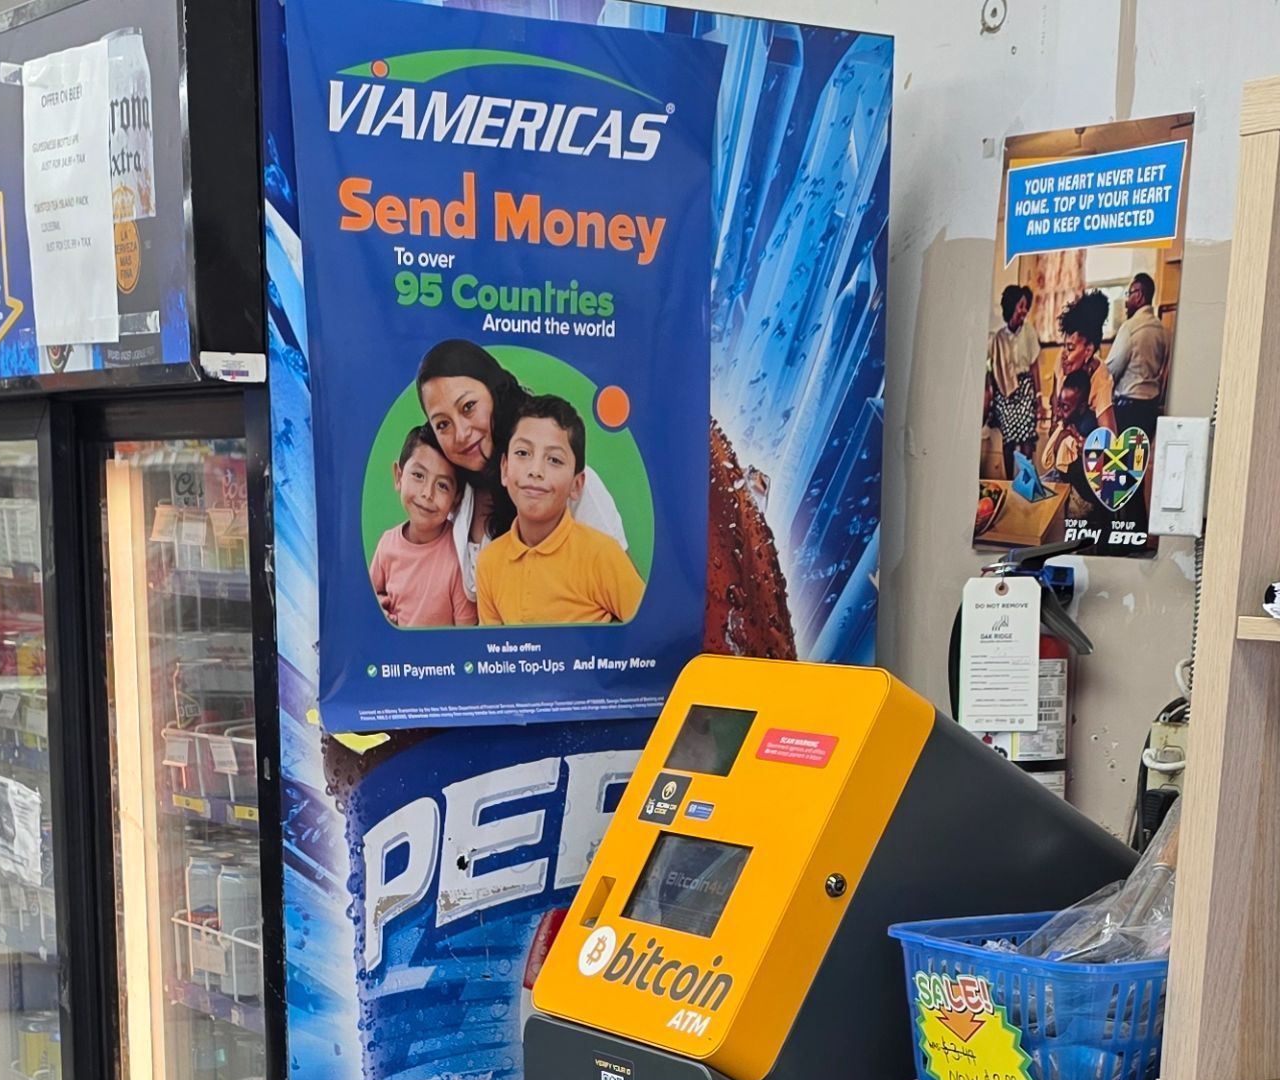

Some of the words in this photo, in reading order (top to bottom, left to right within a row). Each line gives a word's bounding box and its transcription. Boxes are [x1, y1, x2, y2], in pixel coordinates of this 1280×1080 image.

[328, 79, 669, 162] VIAMERICAS
[1025, 177, 1054, 195] YOUR
[1057, 172, 1095, 191] HEART
[1096, 168, 1133, 188] NEVER
[1136, 164, 1167, 183] LEFT
[1015, 198, 1049, 217] HOME.
[1053, 195, 1076, 213] TOP
[1079, 194, 1095, 210] UP
[1097, 190, 1129, 209] YOUR
[1132, 185, 1172, 205] HEART
[338, 171, 477, 240] Send
[494, 191, 667, 265] Money
[1025, 218, 1051, 236] AND
[1053, 215, 1080, 234] KEEP
[1083, 208, 1155, 231] CONNECTED
[394, 246, 414, 266] To
[417, 250, 456, 269] over
[394, 270, 443, 307] 95
[451, 273, 616, 317] Countries
[482, 313, 541, 335] Around
[544, 315, 571, 336] the
[573, 315, 617, 337] world
[1064, 518, 1077, 528] TOP
[1078, 519, 1088, 528] UP
[1111, 520, 1124, 530] TOP
[1125, 521, 1135, 531] UP
[1108, 531, 1148, 545] BTC
[1001, 602, 1029, 610] REMOVE
[486, 643, 500, 653] We
[501, 641, 518, 653] also
[381, 664, 400, 678] Bill
[403, 664, 456, 680] Payment
[477, 660, 517, 675] Mobile
[518, 659, 565, 674] Top-Ups
[573, 655, 595, 670] And
[597, 657, 627, 671] Many
[629, 657, 657, 669] More
[603, 933, 733, 1012] bitcoin
[916, 971, 994, 1015] SALE!
[666, 1009, 711, 1037] ATM
